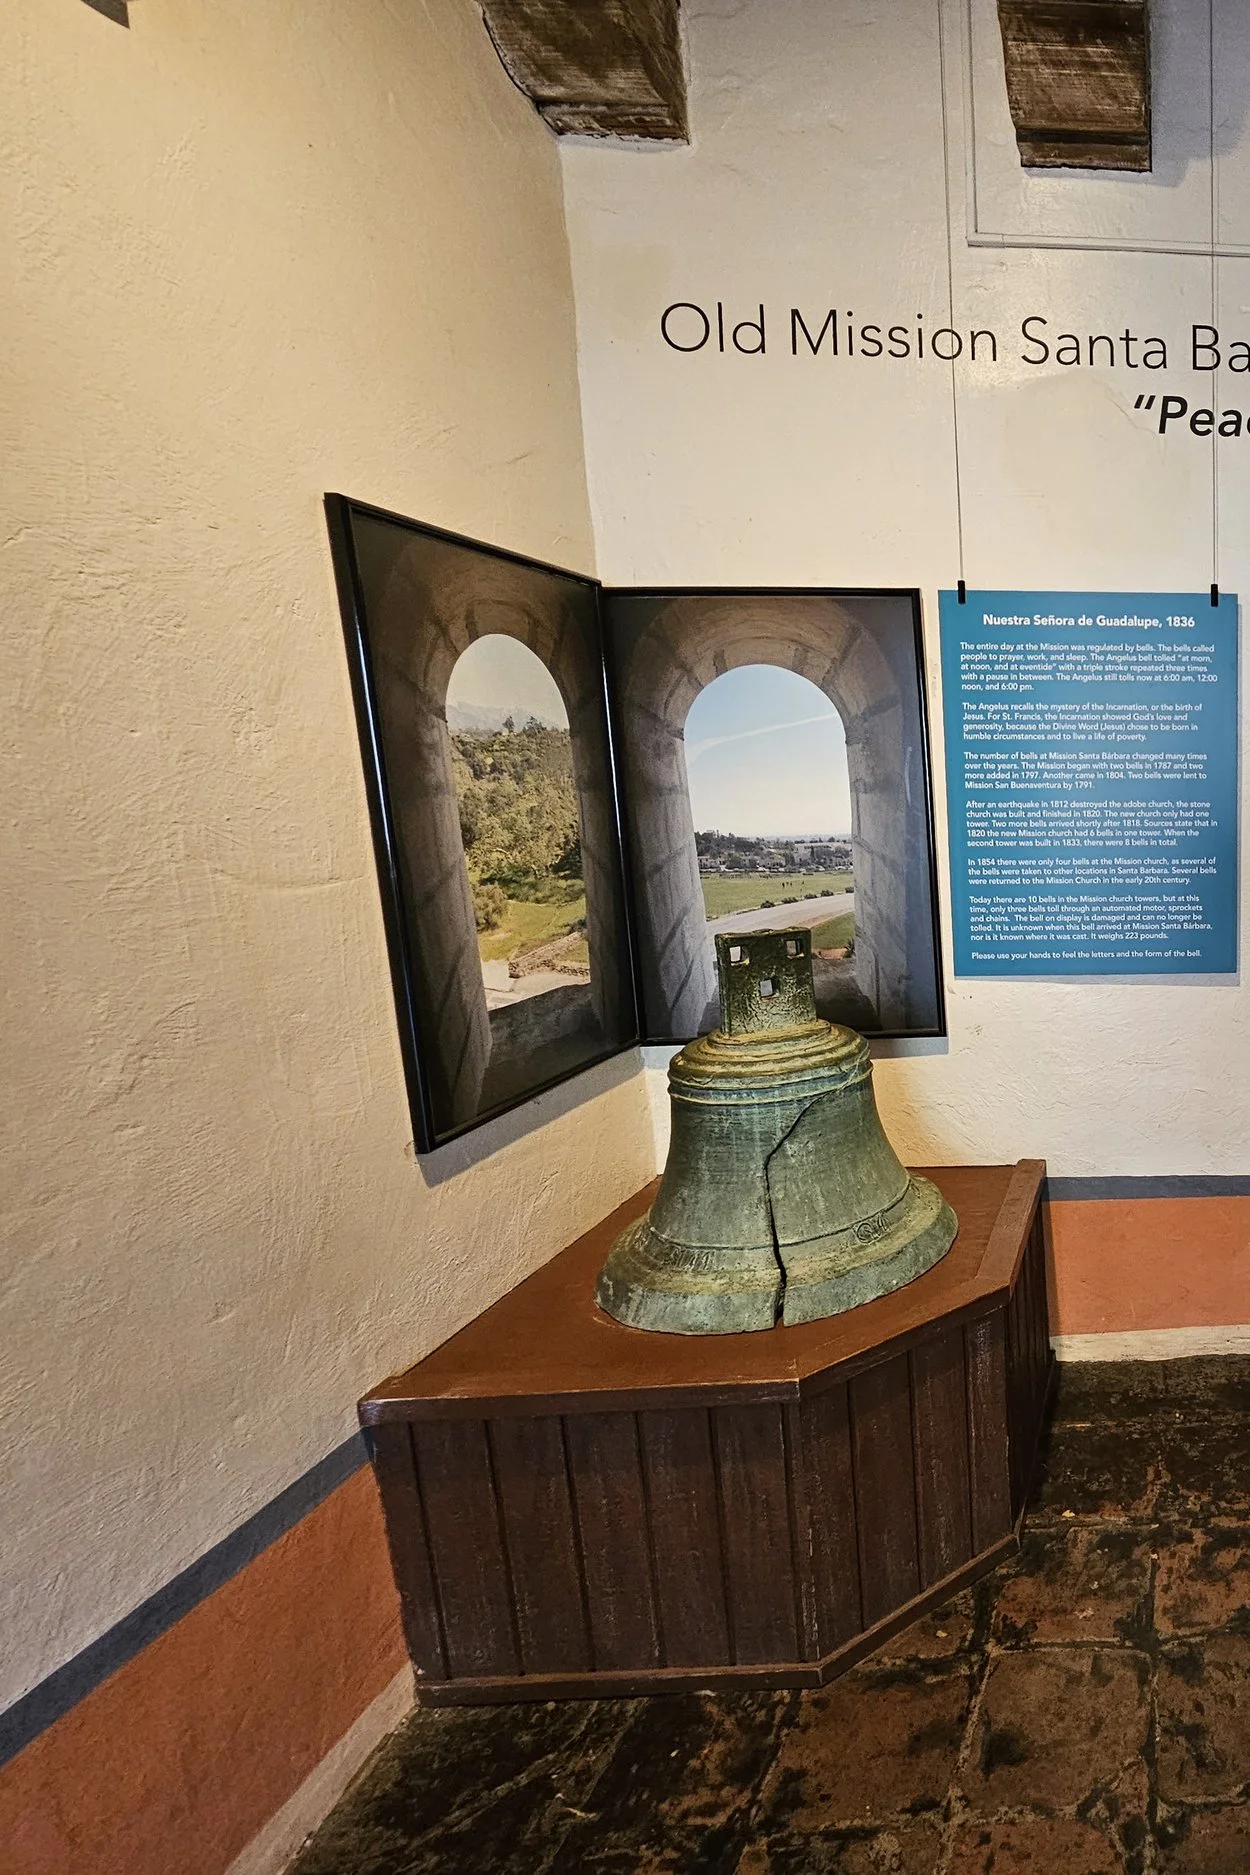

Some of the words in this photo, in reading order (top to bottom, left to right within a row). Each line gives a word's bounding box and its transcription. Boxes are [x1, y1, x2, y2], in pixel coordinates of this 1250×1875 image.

[661, 302, 766, 356] Old
[790, 308, 998, 362] Mission
[1021, 316, 1169, 370] Santa
[983, 614, 1030, 625] Nuestra
[1033, 614, 1074, 625] Señora
[1077, 615, 1093, 625] de
[1096, 615, 1162, 628] Guadalupe,
[1166, 615, 1195, 626] 1836
[960, 642, 974, 650] The
[976, 642, 998, 650] entire
[1000, 642, 1014, 652] day
[1015, 642, 1024, 650] at
[1025, 642, 1038, 650] the
[1040, 642, 1069, 651] Mission
[1086, 643, 1123, 652] regulated
[1124, 643, 1134, 652] by
[1157, 643, 1172, 651] The
[1173, 643, 1191, 651] bells
[1192, 643, 1214, 651] called
[960, 652, 987, 661] people
[988, 652, 997, 660] to
[1049, 652, 1064, 660] and
[1090, 652, 1104, 661] The
[1106, 653, 1137, 662] Angelus
[1138, 653, 1152, 661] bell
[1153, 653, 1175, 661] tolled
[960, 672, 977, 680] with
[985, 673, 1008, 681] pause
[1010, 672, 1017, 680] in
[1056, 672, 1070, 680] The
[1072, 672, 1102, 682] Angelus
[1104, 672, 1117, 680] still
[1118, 672, 1134, 680] tolls
[1154, 672, 1161, 680] at
[1163, 672, 1180, 681] 6:00
[1197, 673, 1217, 681] 12:00
[962, 702, 976, 710] The
[978, 702, 1009, 711] Angelus
[1010, 702, 1034, 710] recalls
[1035, 702, 1048, 710] the
[1050, 702, 1080, 711] mystery
[1081, 702, 1089, 710] of
[1091, 702, 1104, 710] the
[1160, 702, 1173, 710] the
[1175, 702, 1192, 710] birth
[1194, 702, 1202, 710] of
[963, 732, 991, 740] humble
[992, 732, 1045, 740] circumstances
[1046, 732, 1061, 740] and
[1062, 732, 1071, 740] to
[1072, 732, 1086, 740] live
[1094, 732, 1105, 740] life
[1107, 732, 1115, 740] of
[983, 761, 995, 769] the
[1020, 761, 1035, 769] The
[1036, 761, 1065, 769] Mission
[1066, 761, 1090, 770] began
[1092, 761, 1108, 769] with
[1109, 761, 1124, 769] two
[1125, 761, 1143, 769] bells
[1144, 761, 1151, 769] in
[1153, 761, 1171, 769] 1787
[1172, 761, 1187, 769] and
[1188, 761, 1203, 769] two
[1010, 780, 1061, 788] Buenaventura
[1062, 780, 1072, 789] by
[965, 800, 985, 808] After
[997, 800, 1039, 809] earthquake
[1069, 799, 1107, 808] destroyed
[1109, 799, 1121, 807] the
[1123, 799, 1146, 807] adobe
[1176, 799, 1188, 807] the
[1189, 799, 1210, 807] stone
[967, 838, 994, 846] second
[994, 838, 1017, 846] tower
[1034, 838, 1051, 846] built
[1053, 838, 1060, 846] in
[1083, 838, 1103, 846] there
[1150, 837, 1157, 845] in
[988, 876, 1020, 884] returned
[1022, 876, 1030, 884] to
[1031, 876, 1044, 884] the
[1074, 875, 1101, 883] Church
[1102, 875, 1109, 883] in
[1111, 875, 1123, 883] the
[1124, 875, 1143, 884] early
[1144, 875, 1161, 883] 20th
[990, 905, 1005, 914] only
[1007, 904, 1027, 912] three
[1028, 904, 1045, 912] bells
[1046, 904, 1059, 912] toll
[1060, 904, 1090, 913] through
[1102, 903, 1141, 911] automated
[1168, 903, 1202, 912] sprockets
[971, 951, 995, 959] Please
[1029, 950, 1051, 958] hands
[1052, 950, 1060, 958] to
[1062, 950, 1076, 958] feel
[1091, 949, 1114, 957] letters
[1116, 949, 1129, 957] and
[1131, 949, 1143, 957] the
[1144, 949, 1162, 957] form
